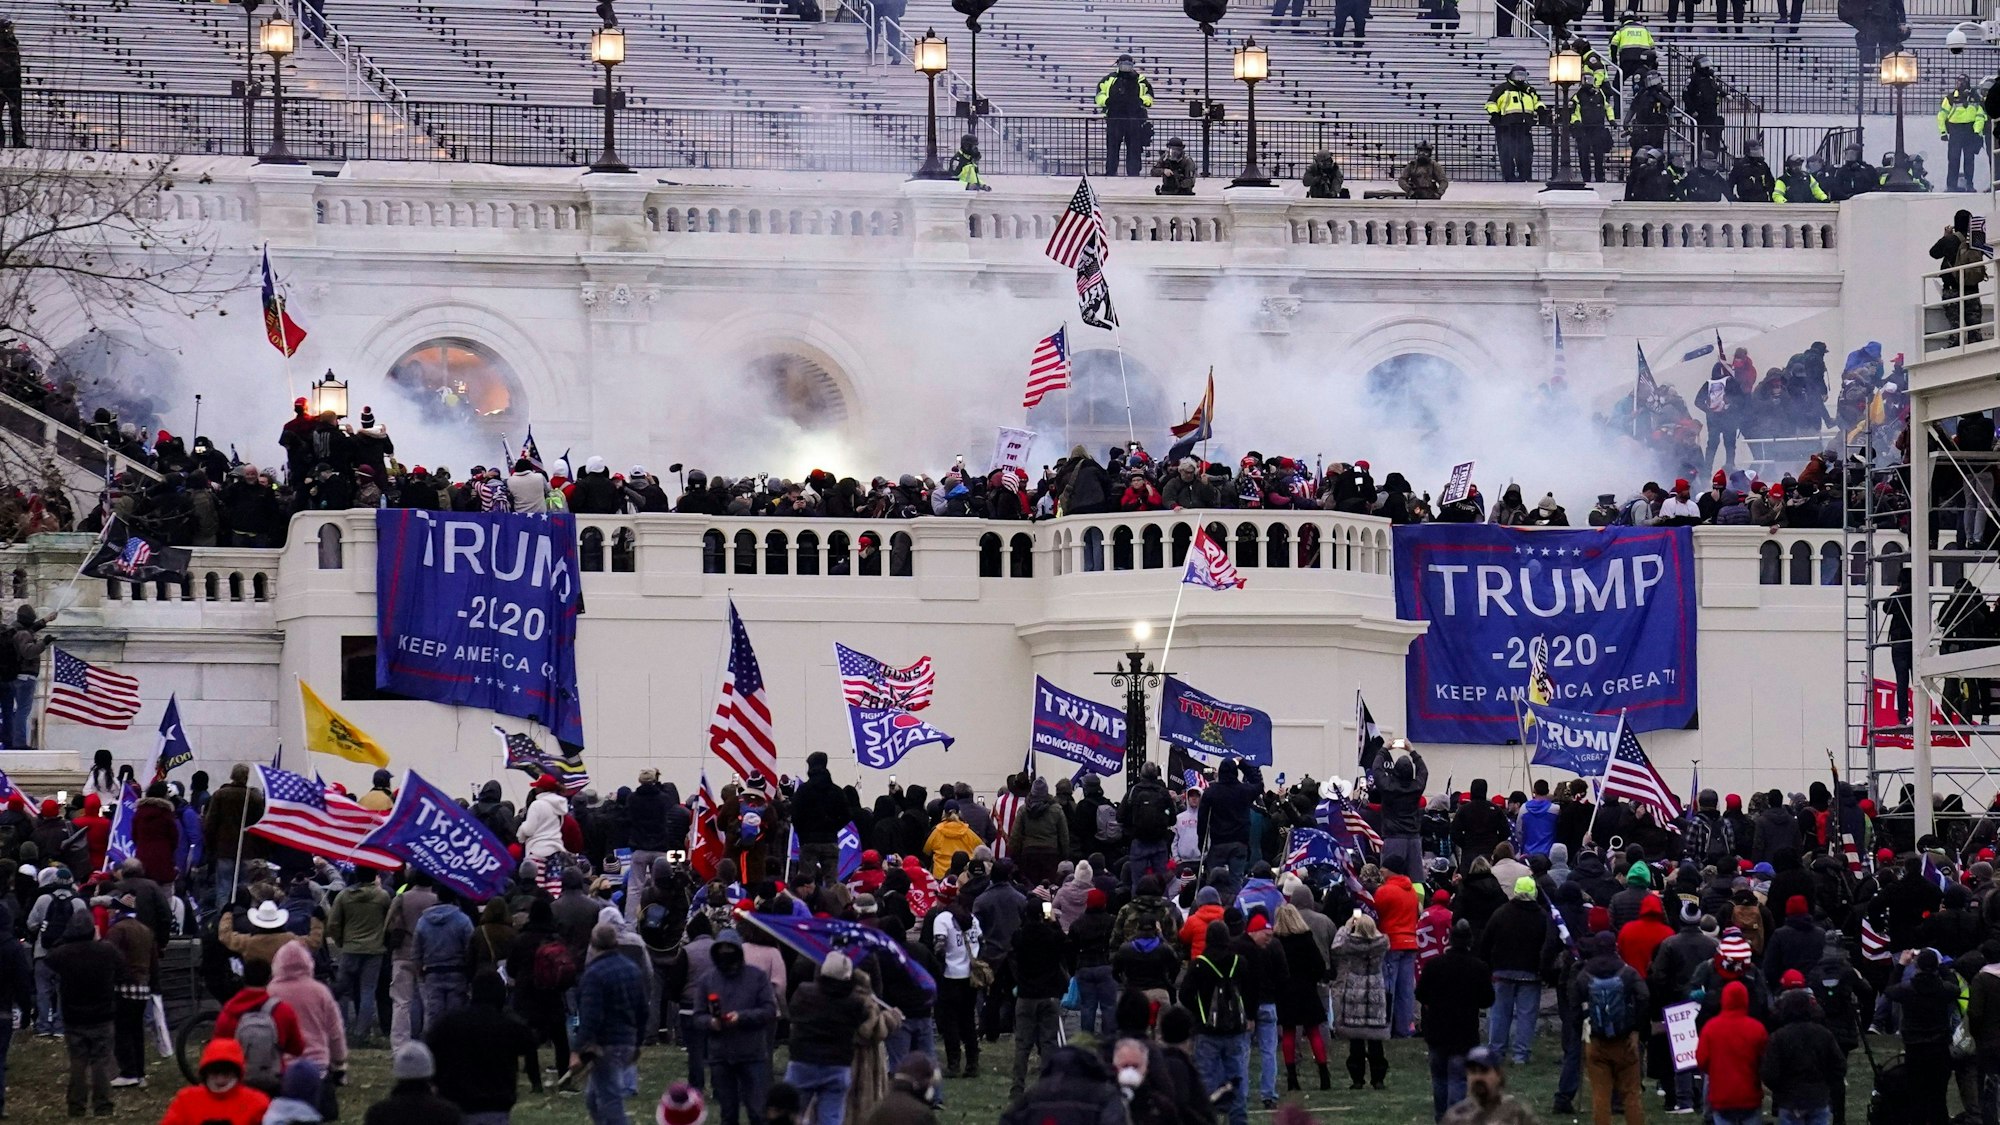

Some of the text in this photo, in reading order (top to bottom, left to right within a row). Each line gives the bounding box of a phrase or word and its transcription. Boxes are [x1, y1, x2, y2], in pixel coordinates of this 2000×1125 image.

[1456, 463, 1471, 498] TRUMP
[1203, 538, 1238, 586] RUM
[1428, 553, 1665, 618] TRUMP
[398, 634, 448, 658] KEEP
[453, 644, 531, 674] AMECA
[882, 662, 921, 682] GUNS
[1435, 668, 1676, 702] KEEP AMICA GREAT!
[860, 711, 886, 720] FIGHT
[1040, 687, 1127, 738] TRUMP
[1178, 696, 1253, 731] TRUMP
[1036, 732, 1052, 745] NO
[1052, 738, 1084, 755] MORE
[1172, 732, 1257, 761] KEEP AMERICA GAT
[1580, 753, 1603, 762] GREAT
[415, 797, 501, 875] TRUMP
[406, 842, 447, 875] AMERICA
[1291, 856, 1317, 871] KEEP
[1667, 1010, 1691, 1023] KEEP
[1673, 1033, 1686, 1043] TO
